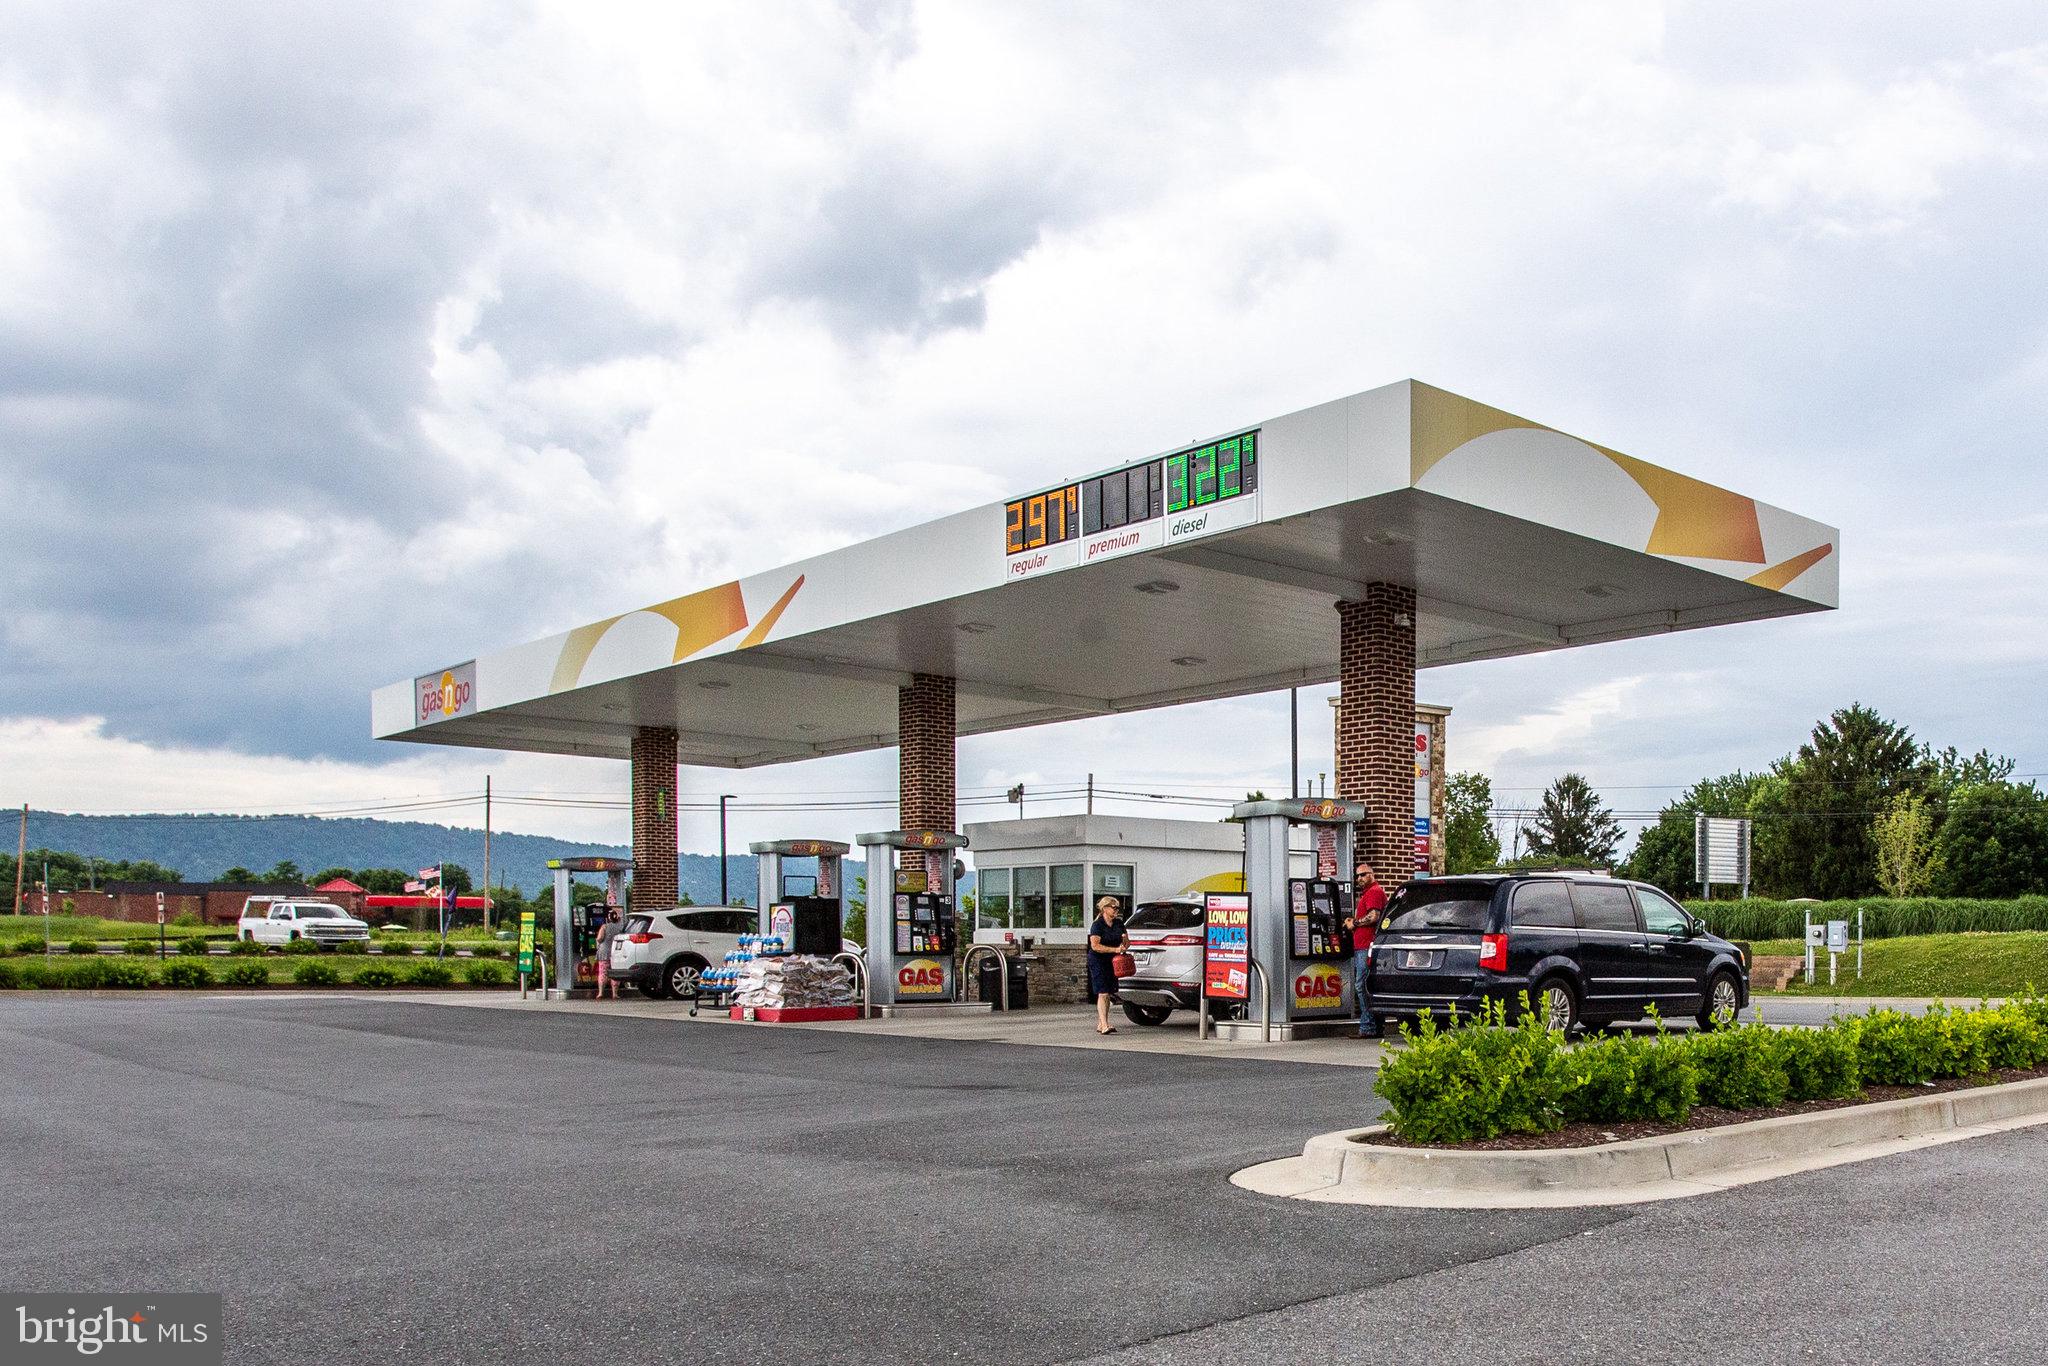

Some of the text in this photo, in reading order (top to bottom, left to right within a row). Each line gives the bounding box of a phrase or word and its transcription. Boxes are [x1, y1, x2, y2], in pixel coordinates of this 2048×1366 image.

[1172, 514, 1208, 537] diesel
[1088, 534, 1140, 559] premium
[1011, 554, 1048, 576] regular
[1208, 910, 1248, 926] LOW, LOW
[1208, 927, 1247, 944] PRICES
[898, 968, 944, 986] GAS
[1295, 974, 1342, 998] GAS
